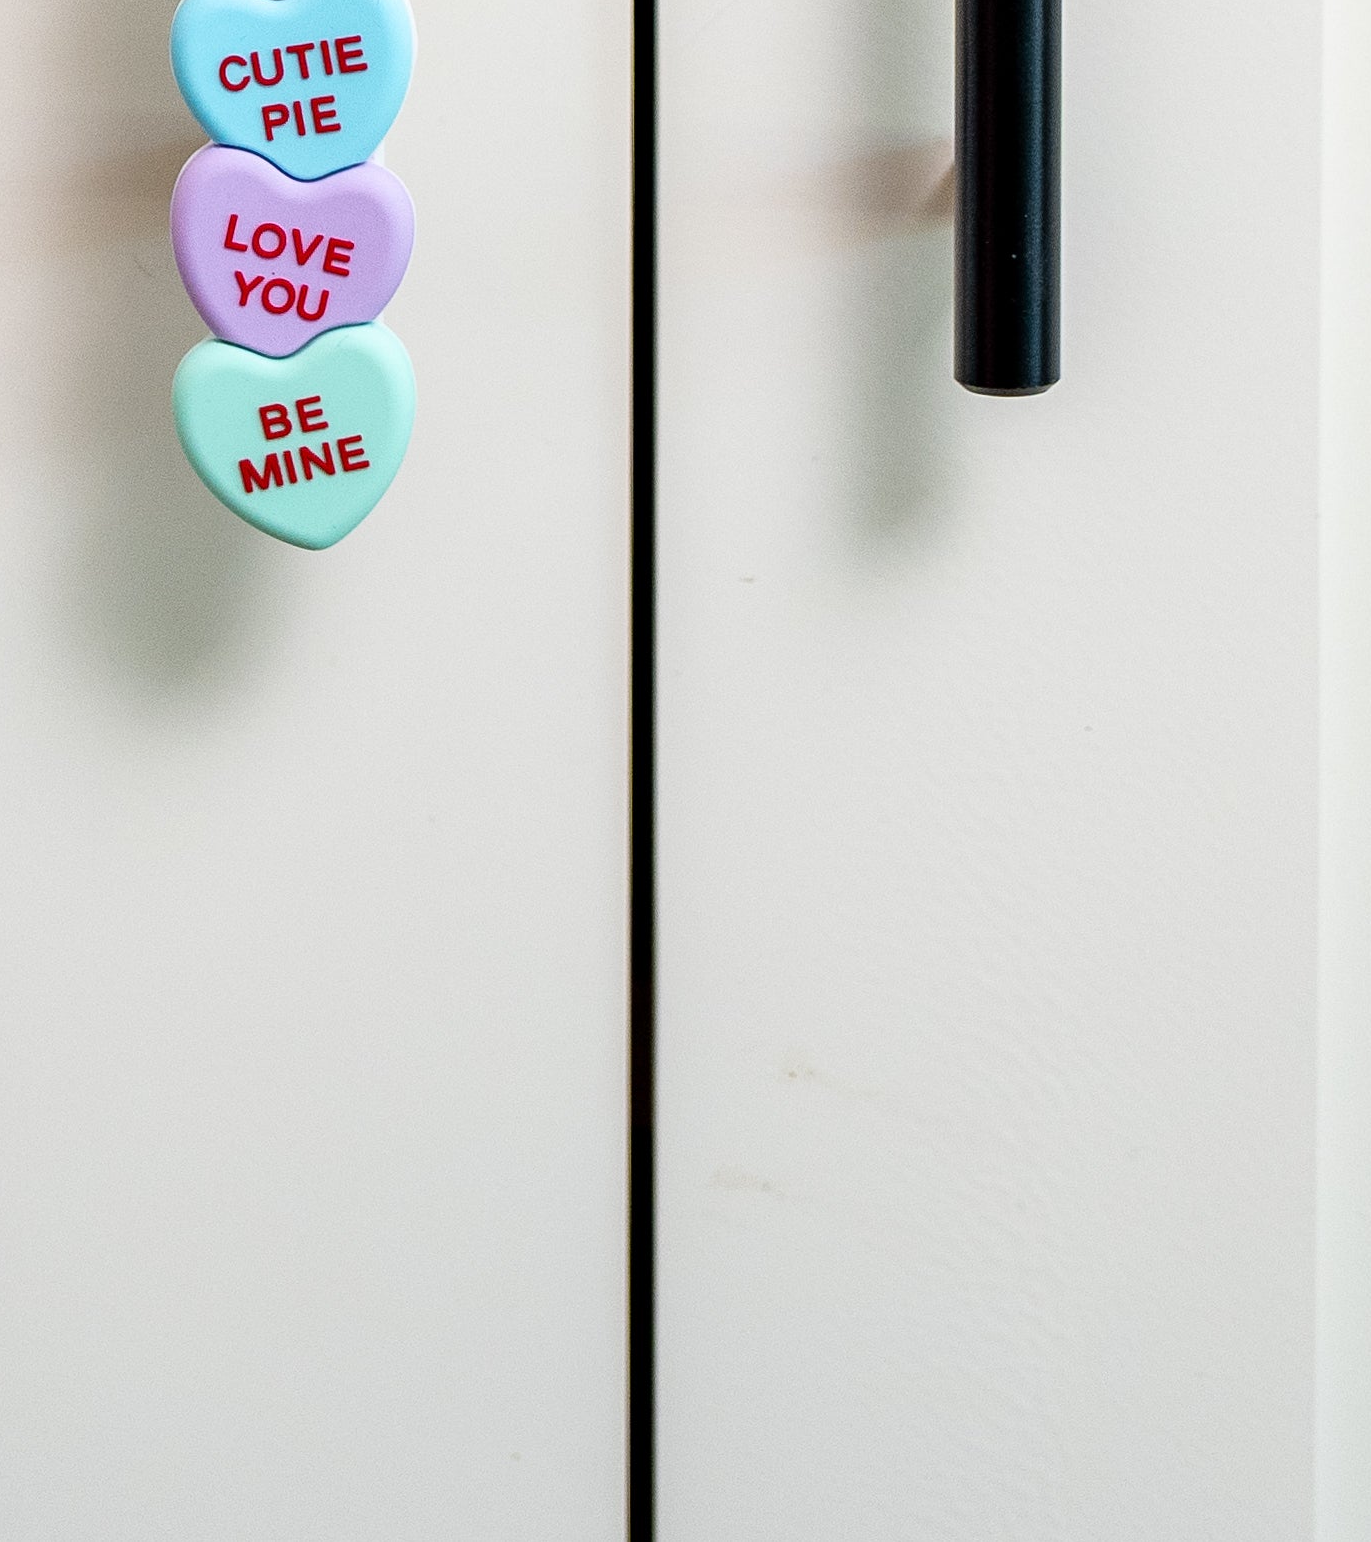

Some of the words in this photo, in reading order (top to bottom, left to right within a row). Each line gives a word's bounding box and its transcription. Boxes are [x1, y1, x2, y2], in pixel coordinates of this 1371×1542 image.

[219, 35, 368, 91] CUTIE
[262, 95, 341, 141] PIE
[223, 213, 355, 278] LOVE
[233, 270, 330, 323] YOU
[259, 395, 329, 440] BE
[239, 435, 370, 493] MINE
